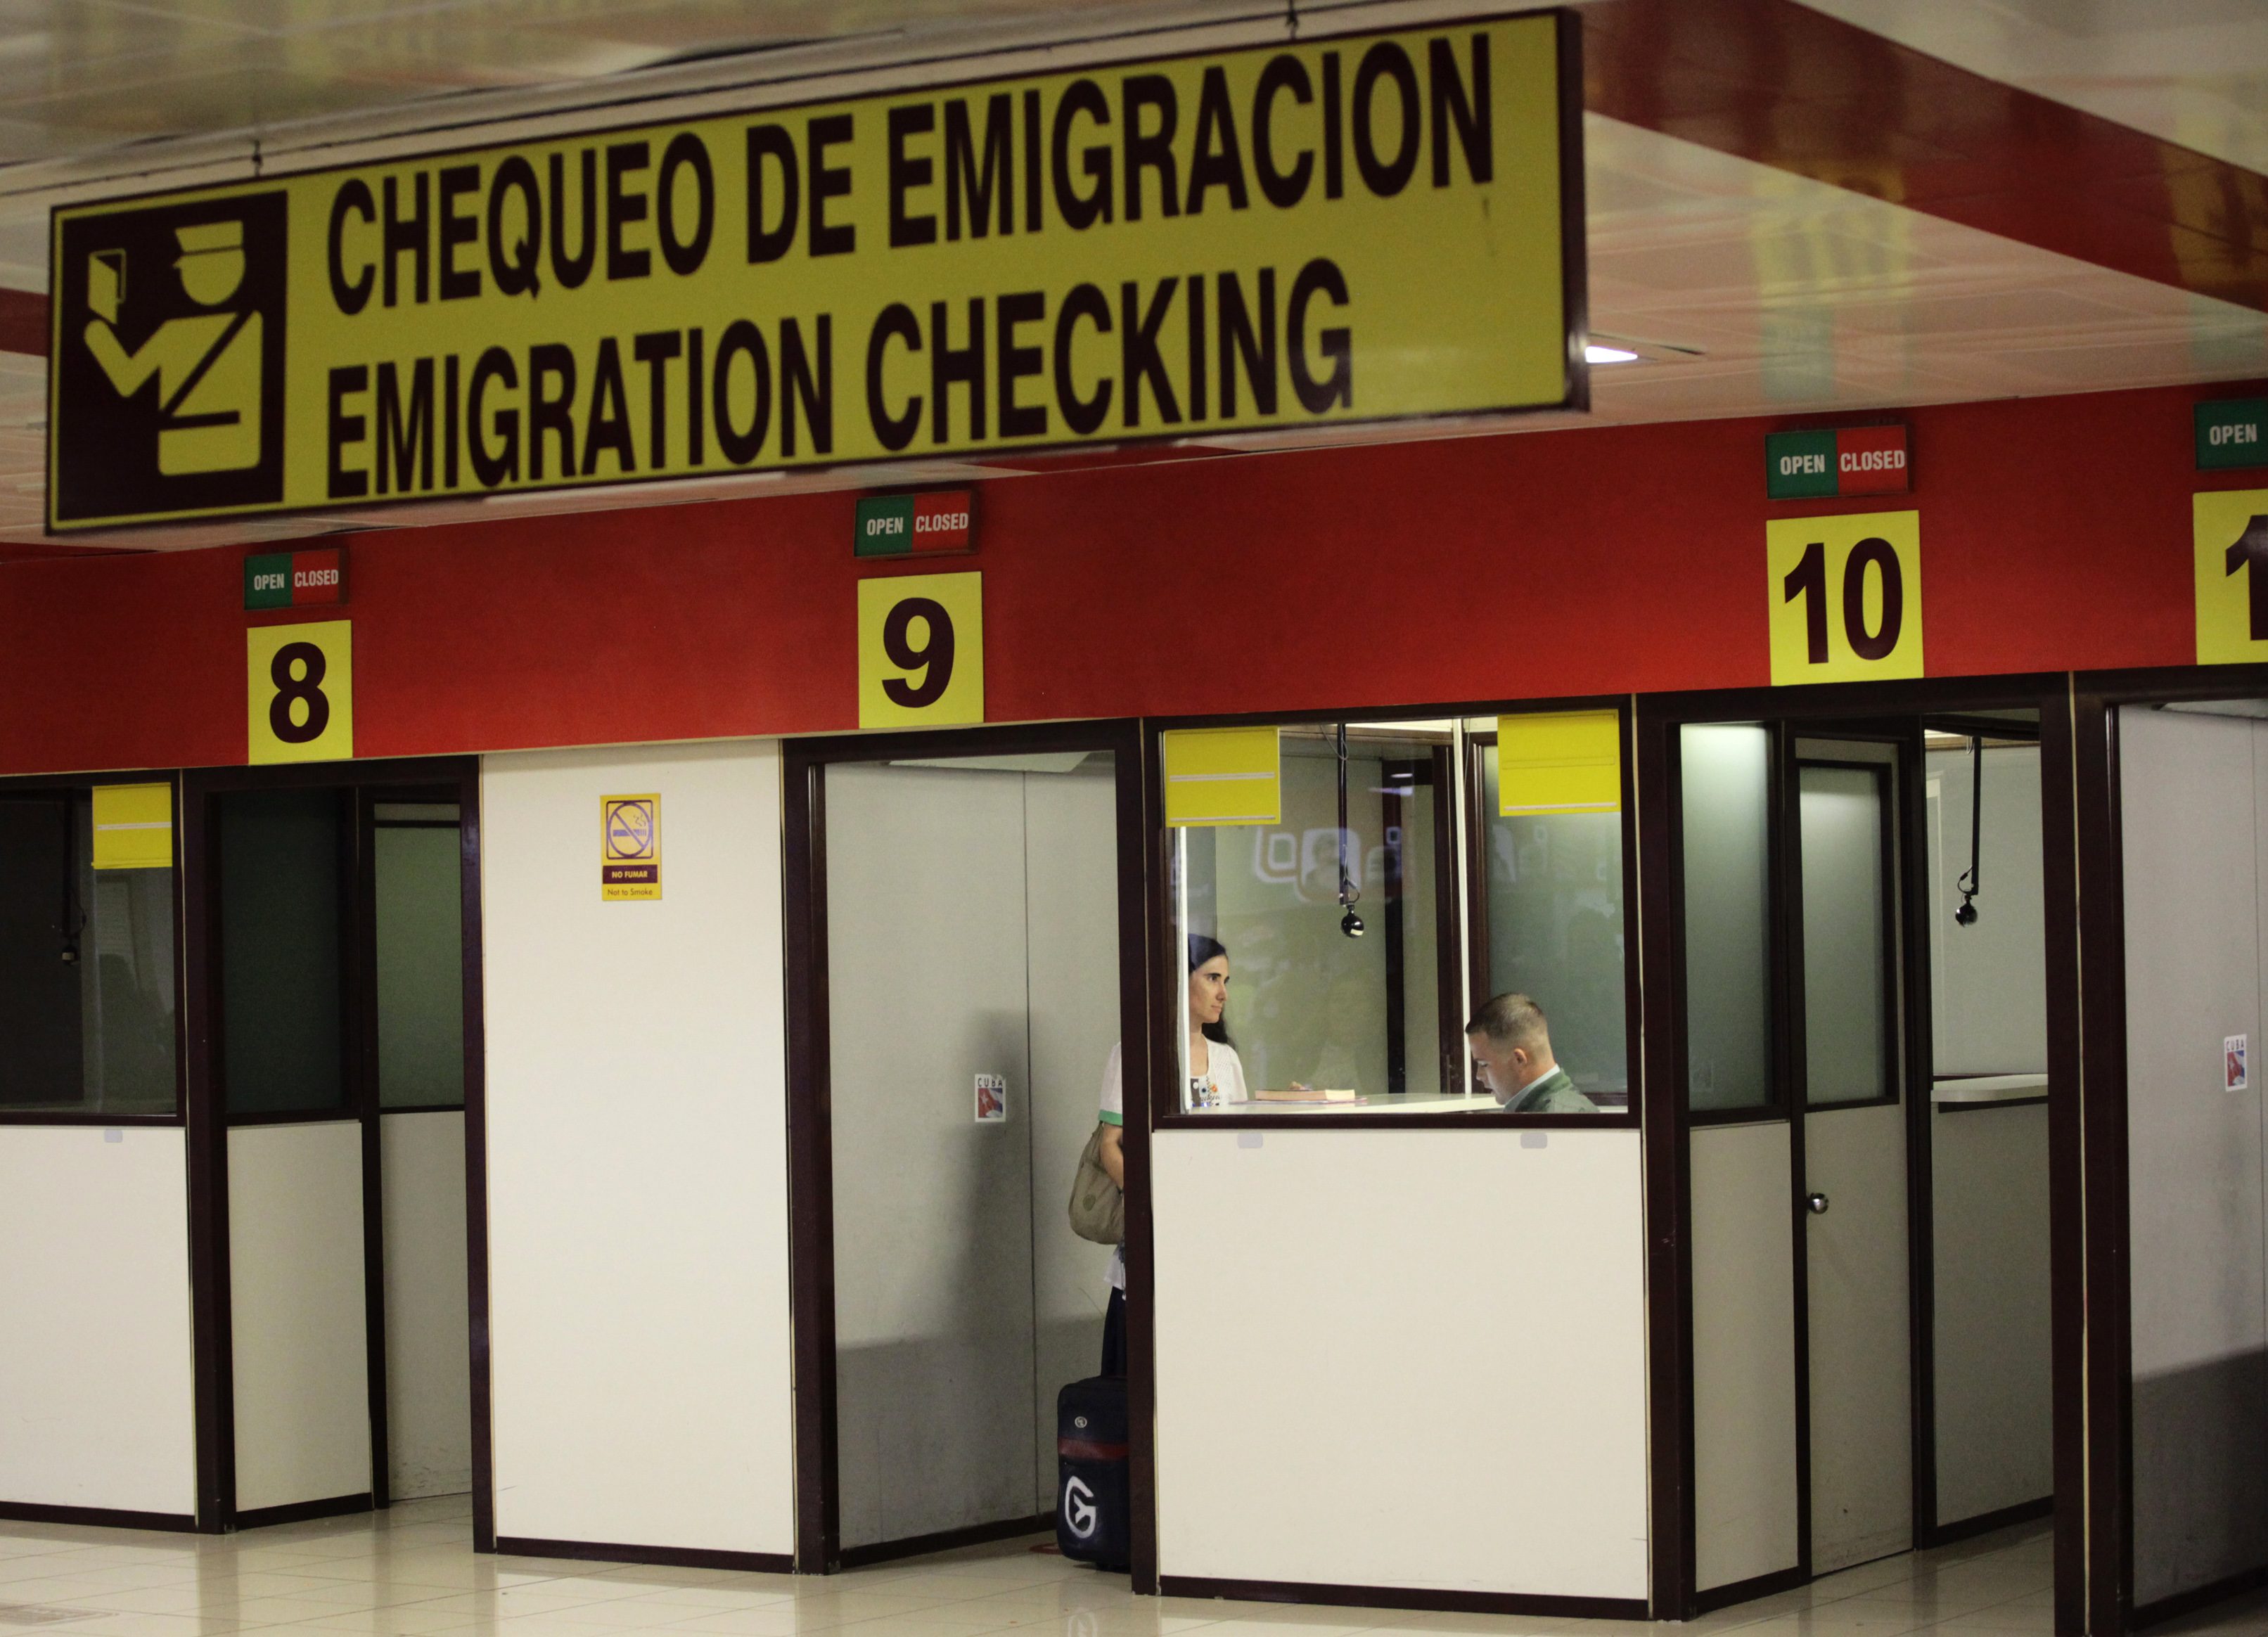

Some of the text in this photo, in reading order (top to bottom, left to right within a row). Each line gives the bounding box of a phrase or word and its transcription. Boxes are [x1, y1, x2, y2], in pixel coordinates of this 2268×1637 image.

[328, 33, 1493, 316] CHEQUEO DE EMIGRACION
[327, 257, 1353, 500] EMIGRATION CHECKING
[1780, 450, 1905, 475] OPEN CLOSED
[2210, 423, 2258, 446] OPEN
[866, 513, 968, 536] OPEN CLOSED
[254, 569, 339, 591] OPEN CLOSED
[1784, 537, 1903, 665] 10
[269, 641, 330, 744] 8
[881, 597, 955, 709] 9
